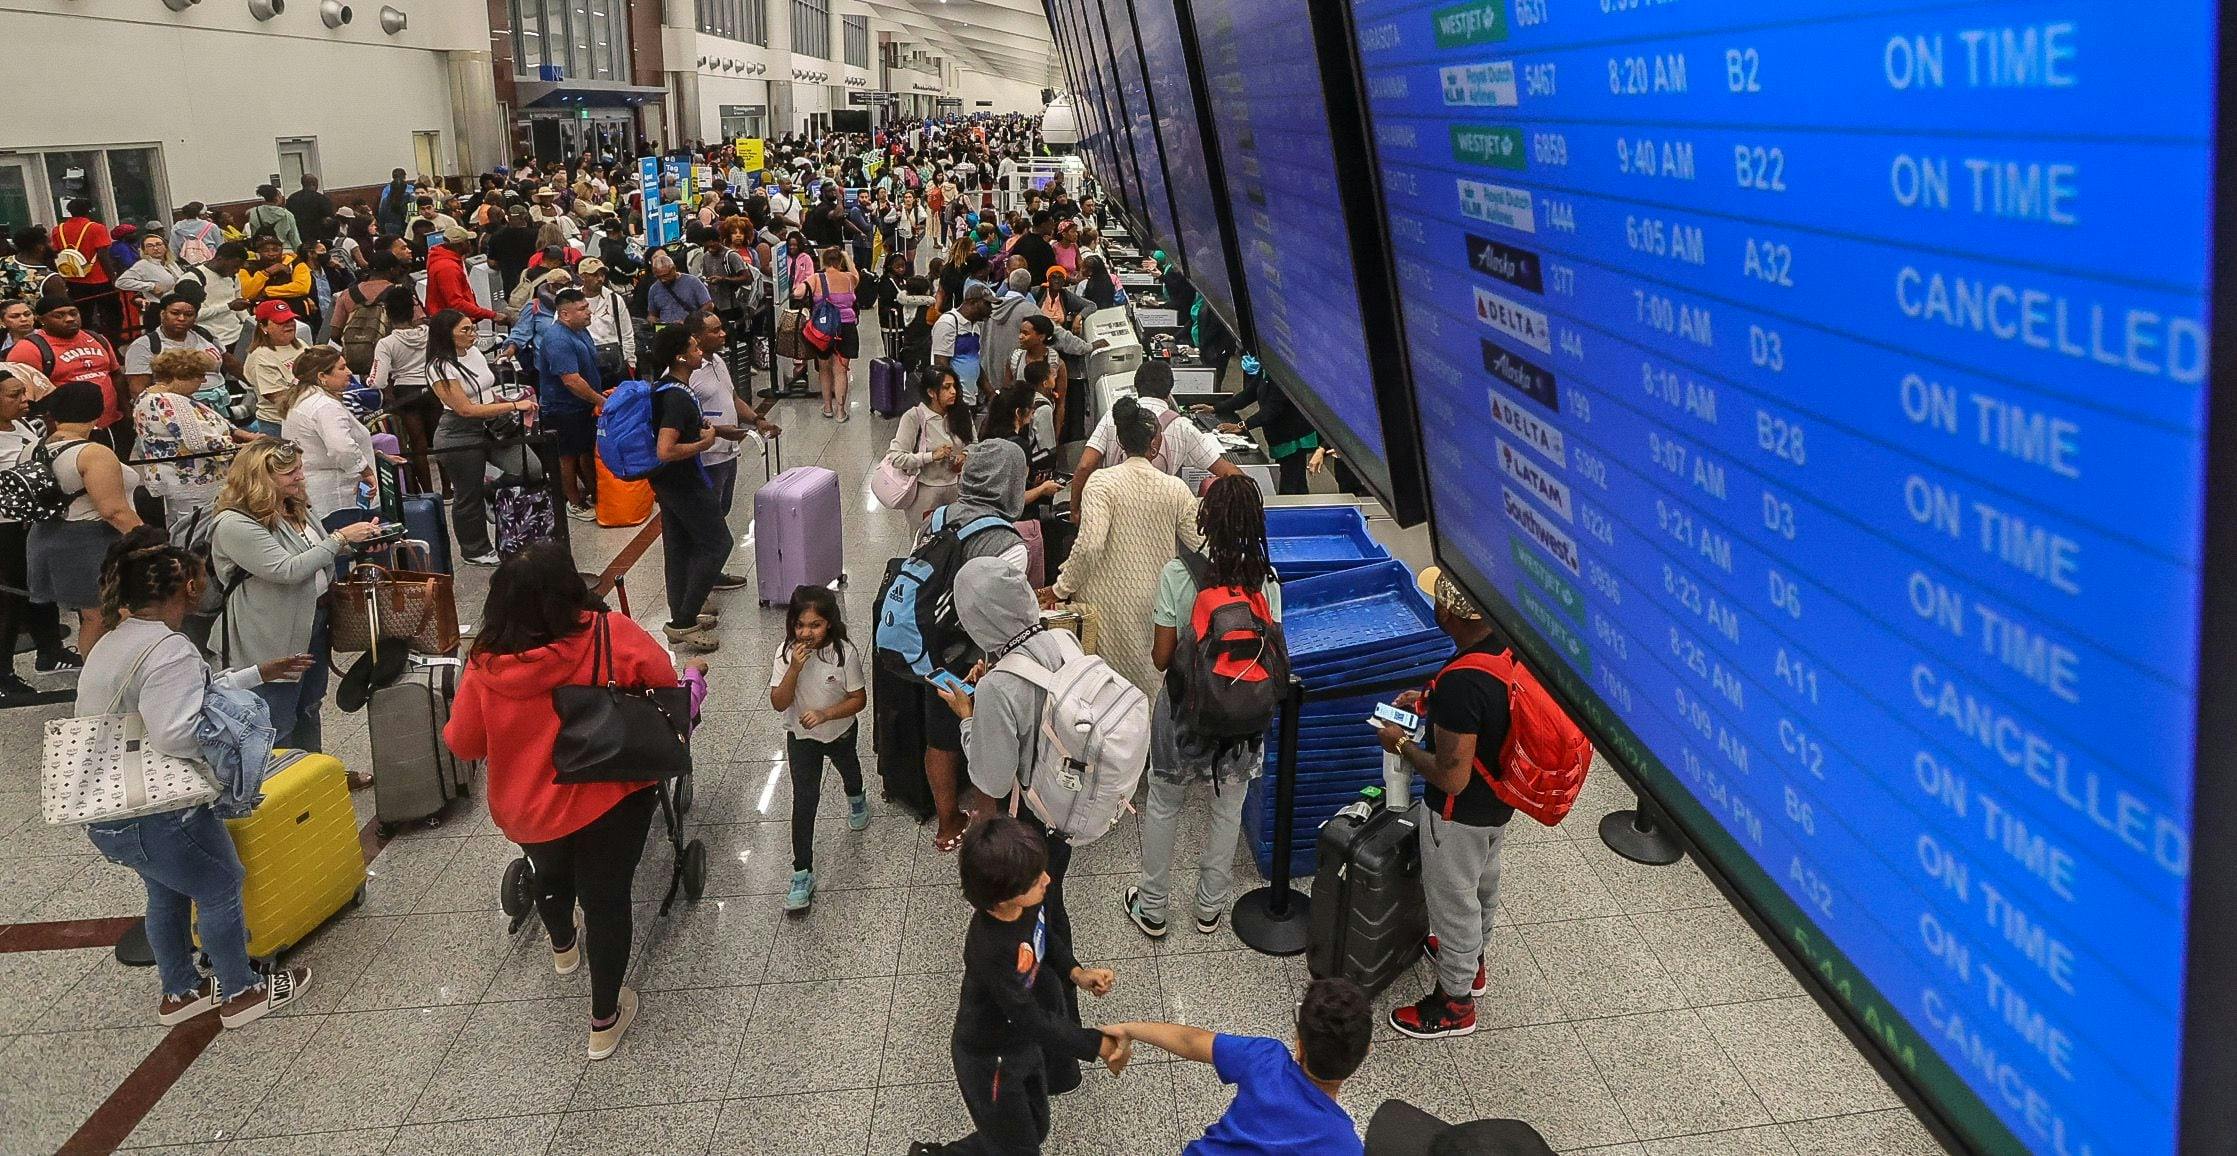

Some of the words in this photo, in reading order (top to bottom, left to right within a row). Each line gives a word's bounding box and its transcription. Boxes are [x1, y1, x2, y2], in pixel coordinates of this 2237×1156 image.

[1439, 8, 1486, 39] WESTJET
[1524, 62, 1556, 96] 5467
[1608, 56, 1649, 95] 8:20
[1654, 53, 1687, 92] AM
[1725, 47, 1761, 93] B2
[1884, 35, 1943, 90] ON
[1959, 22, 2073, 86] TIME
[665, 164, 679, 172] Tag
[1457, 133, 1503, 160] WESTJET
[1533, 133, 1567, 166] 6859
[1616, 137, 1657, 176] 9:40
[1662, 141, 1694, 178] AM
[1734, 144, 1786, 191] B22
[1891, 154, 1949, 208] ON
[1964, 158, 2075, 224] TIME
[1478, 244, 1516, 279] Alaska
[1541, 198, 1576, 233] 7444
[1626, 215, 1666, 256] 6:05
[1671, 223, 1705, 264] AM
[1743, 238, 1793, 287] A32
[1896, 266, 2209, 384] CANCELLED
[59, 347, 104, 363] GEORGIA
[1488, 300, 1535, 339] DELTA
[1493, 353, 1531, 389] Alaska
[1550, 263, 1574, 297] 377
[1633, 289, 1674, 334] 7:00
[1679, 304, 1712, 346] AM
[1749, 324, 1784, 372] D3
[1901, 373, 1957, 433] ON
[1971, 393, 2078, 478] TIME
[1503, 404, 1550, 451] DELTA
[1559, 327, 1584, 361] 444
[1642, 362, 1681, 407] 8:10
[1685, 381, 1717, 424] AM
[1756, 409, 1806, 465] B28
[1904, 474, 1960, 538] ON
[1973, 502, 2079, 594] TIME
[1514, 458, 1562, 508] LATAM
[1503, 491, 1571, 565] Southwest
[1566, 388, 1591, 423] 199
[1649, 431, 1686, 476] 9:07
[1693, 456, 1726, 500] AM
[1762, 490, 1796, 540] D3
[1908, 571, 1963, 636] ON
[1974, 603, 2077, 702] TIME
[1574, 447, 1608, 491] 5302
[1656, 499, 1694, 548] 9:21
[1700, 527, 1732, 573] AM
[1768, 569, 1801, 619] D6
[1911, 663, 2189, 876] CANCELLED
[1581, 503, 1614, 546] 6224
[1662, 563, 1702, 615] 8:23
[1707, 598, 1739, 644] AM
[1774, 648, 1818, 705] A11
[1914, 751, 1966, 817] ON
[1978, 794, 2074, 901] TIME
[1669, 626, 1708, 679] 8:25
[1712, 663, 1744, 711] AM
[1778, 718, 1824, 780] C12
[1917, 834, 1968, 901] ON
[1980, 881, 2073, 993] TIME
[1675, 687, 1712, 740] 9:09
[1718, 726, 1749, 775] AM
[1784, 784, 1815, 836] B6
[1919, 912, 1970, 981] ON
[1981, 964, 2071, 1079] TIME
[1682, 747, 1728, 810] 10:54
[1732, 796, 1763, 847] PM
[1789, 855, 1834, 919] A32
[1921, 988, 2093, 1156] CANCEL
[1866, 1007, 1916, 1070] AM
